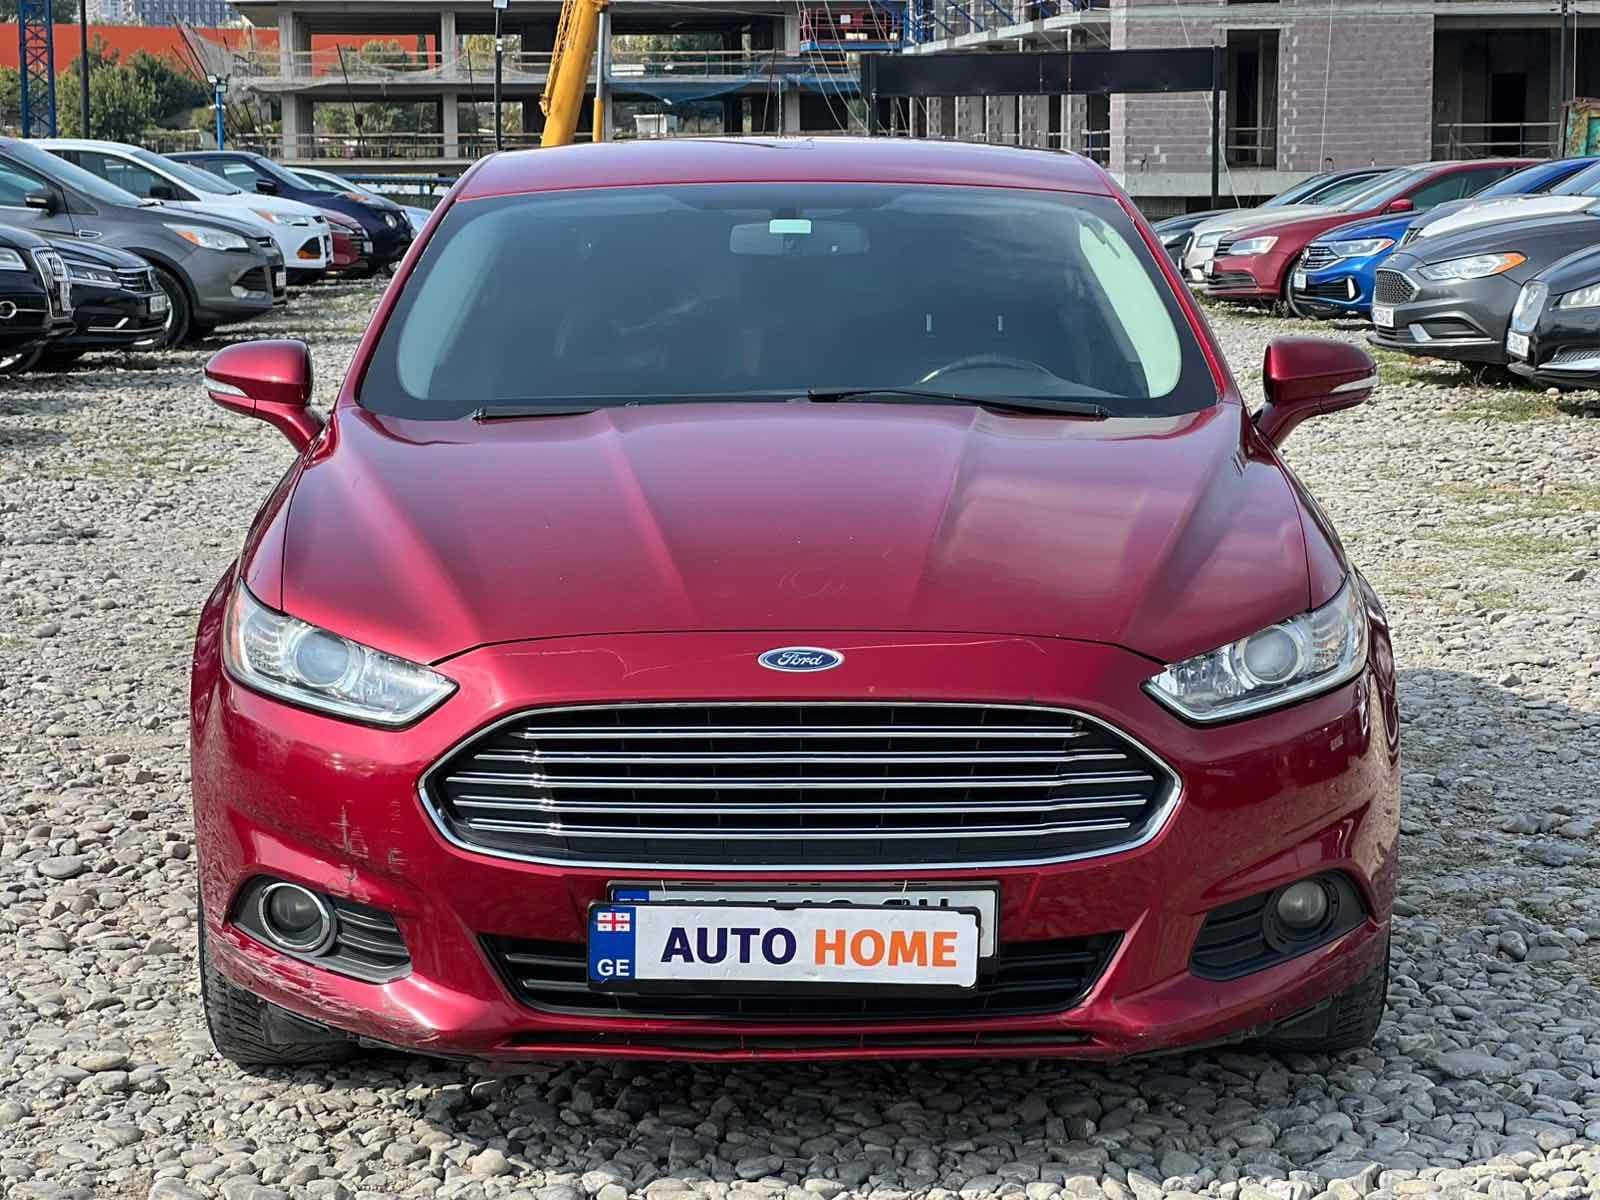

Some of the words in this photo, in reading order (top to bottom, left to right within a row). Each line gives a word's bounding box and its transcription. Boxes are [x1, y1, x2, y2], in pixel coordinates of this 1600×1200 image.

[778, 652, 824, 665] Ford
[661, 927, 795, 964] AUTO
[814, 929, 958, 967] HOME
[597, 959, 629, 977] GE
